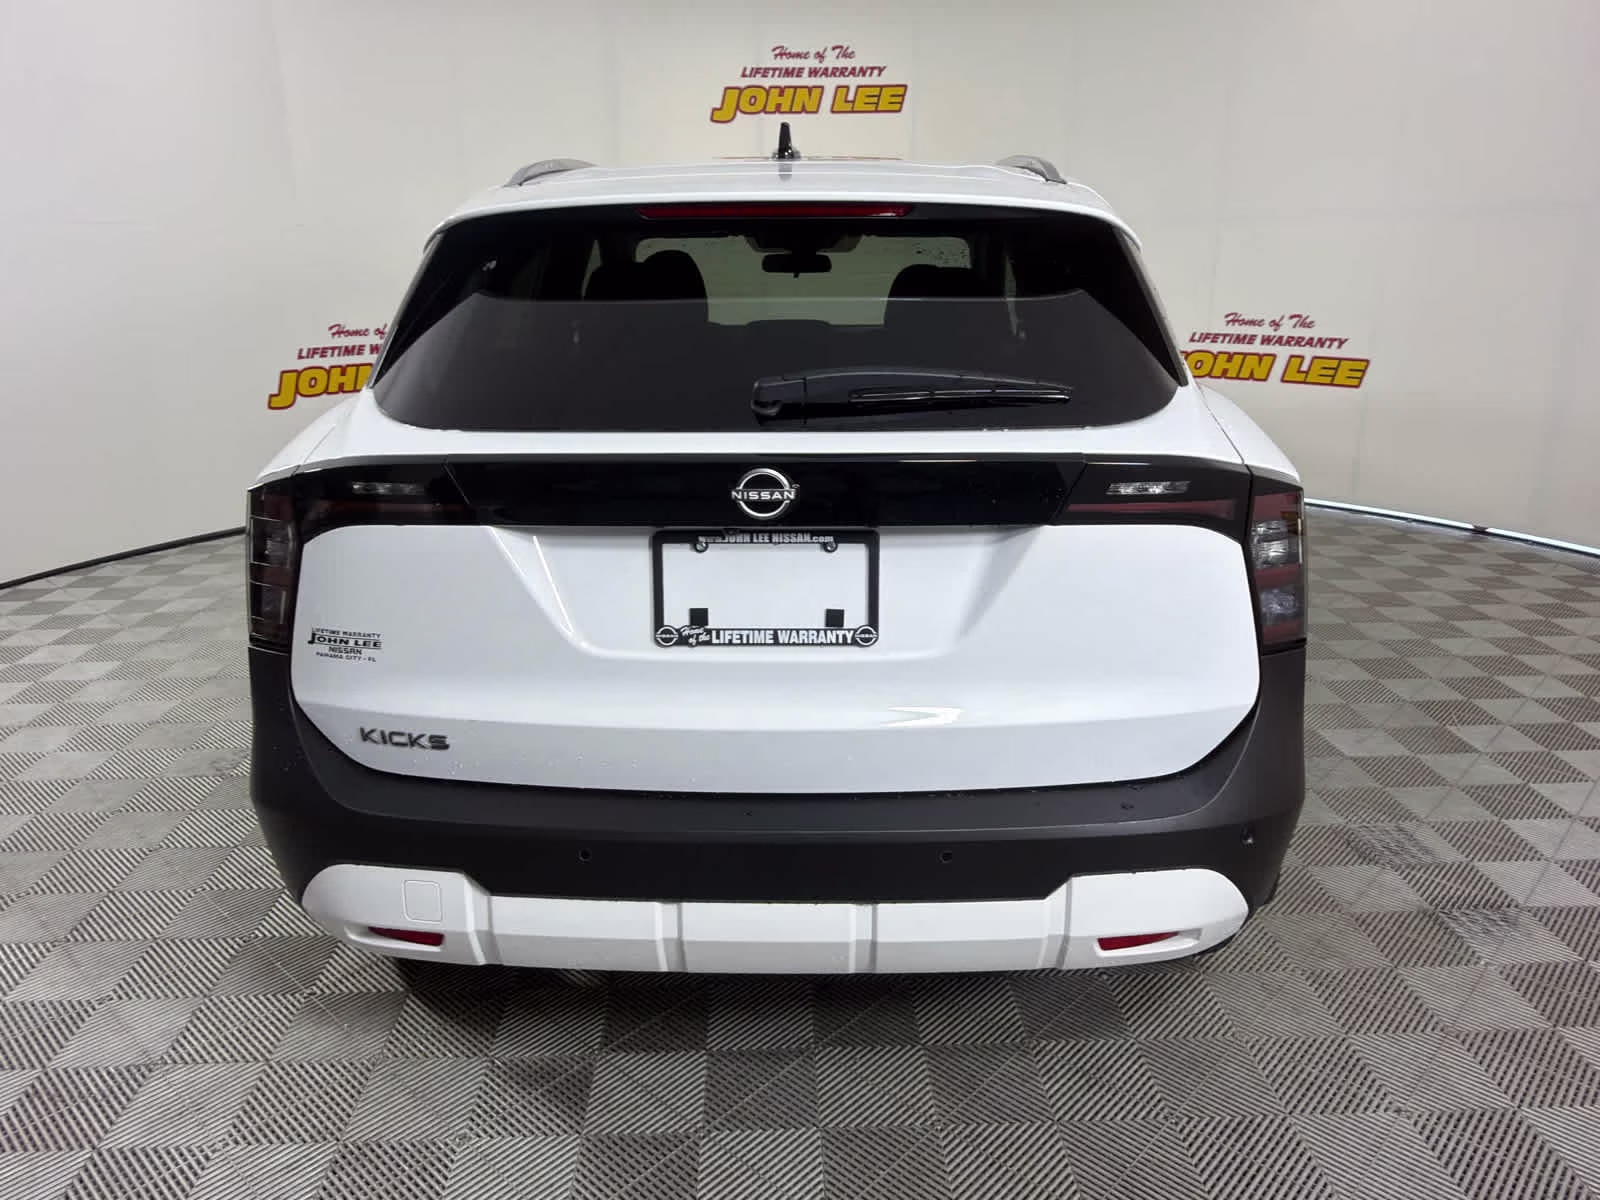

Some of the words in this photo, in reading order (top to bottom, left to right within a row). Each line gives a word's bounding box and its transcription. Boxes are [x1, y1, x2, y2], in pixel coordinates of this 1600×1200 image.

[771, 45, 810, 60] Home
[814, 47, 828, 63] of
[831, 45, 856, 60] The
[741, 67, 805, 78] LIFETIME
[807, 66, 887, 78] WARRANTY
[710, 85, 824, 124] JOHN
[830, 84, 908, 114] LEE
[1224, 312, 1265, 328] Home
[1269, 315, 1284, 331] of
[1288, 314, 1316, 329] The
[328, 323, 370, 339] Home
[374, 323, 388, 340] of
[1189, 332, 1257, 345] LIFETIME
[1260, 334, 1349, 349] WARRANTY
[297, 344, 366, 360] LIFETIME
[1180, 349, 1277, 382] OHN
[1280, 354, 1371, 388] LEE
[731, 490, 796, 500] NISSAN
[753, 532, 770, 543] LEE
[307, 632, 350, 646] JOHN
[354, 639, 383, 648] LEE
[711, 630, 774, 644] LIFETIME
[777, 630, 855, 644] WARRANTY
[328, 646, 363, 655] NISSAN
[360, 727, 450, 750] KICKS
